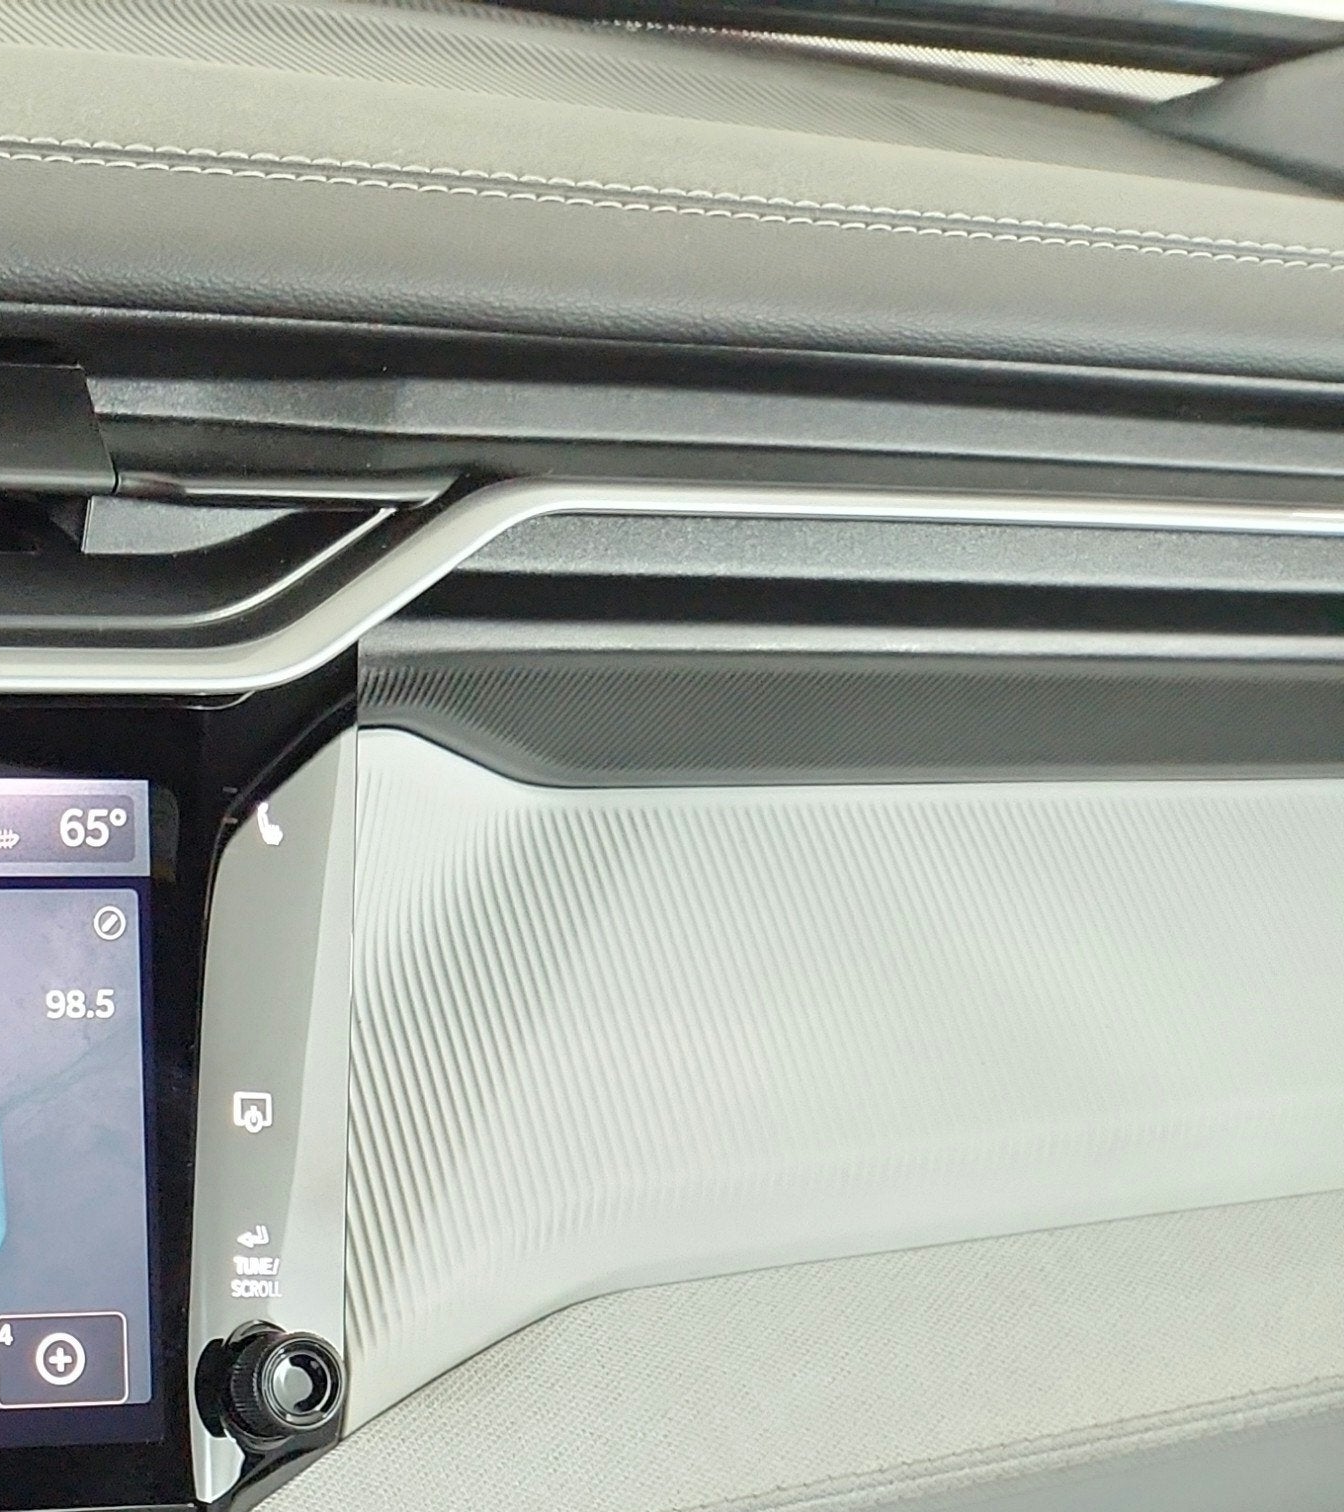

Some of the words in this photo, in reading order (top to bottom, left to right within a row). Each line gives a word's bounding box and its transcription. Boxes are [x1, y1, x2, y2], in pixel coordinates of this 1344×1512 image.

[58, 806, 128, 848] 65°
[44, 987, 116, 1020] 98.5
[230, 1278, 282, 1299] SCROLL
